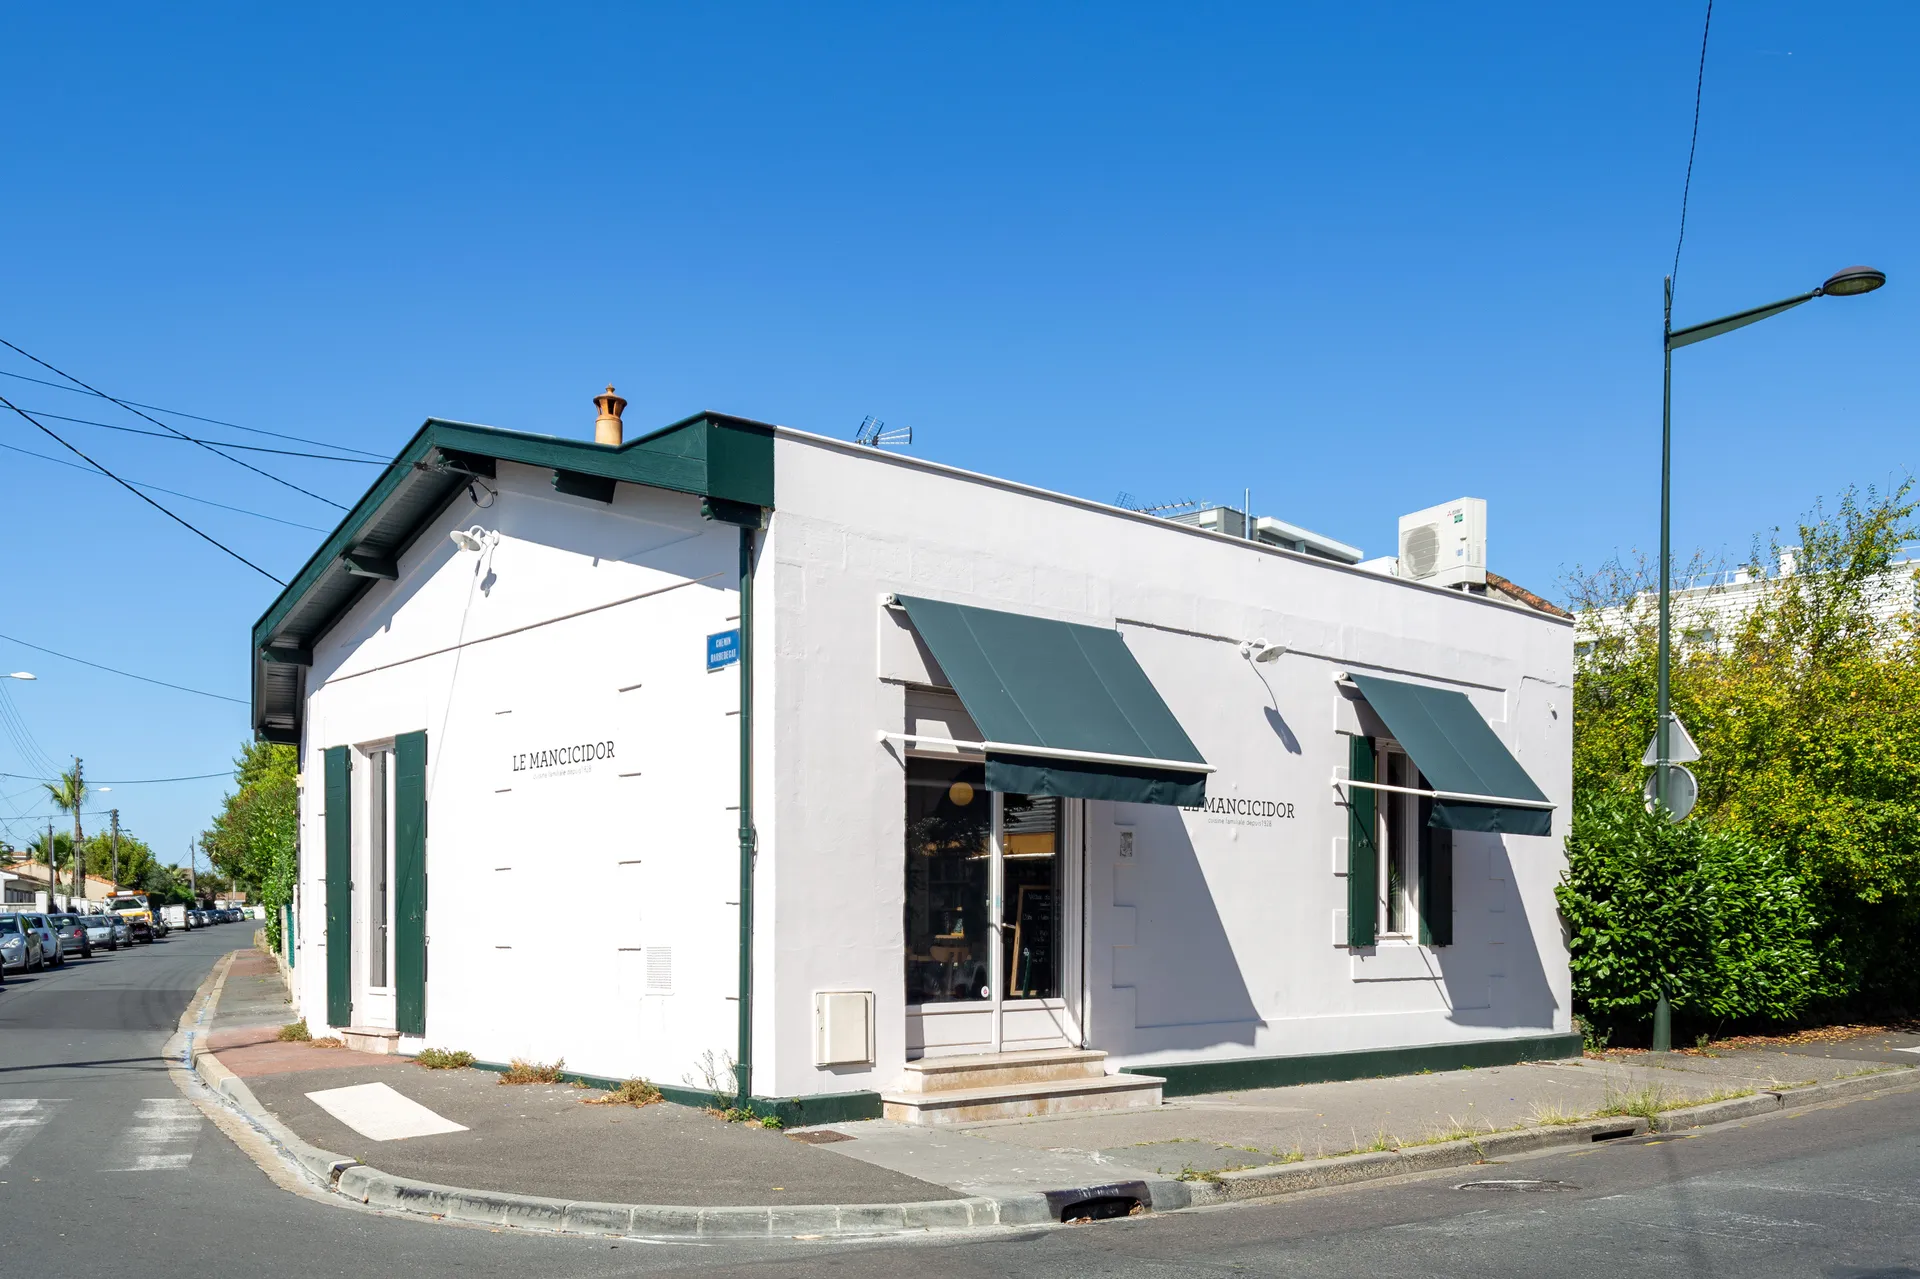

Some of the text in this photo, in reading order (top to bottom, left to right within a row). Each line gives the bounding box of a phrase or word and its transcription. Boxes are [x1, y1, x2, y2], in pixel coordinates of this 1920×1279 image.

[513, 741, 615, 771] LE MANCICIDOR
[1203, 797, 1295, 819] MANCICIDOR
